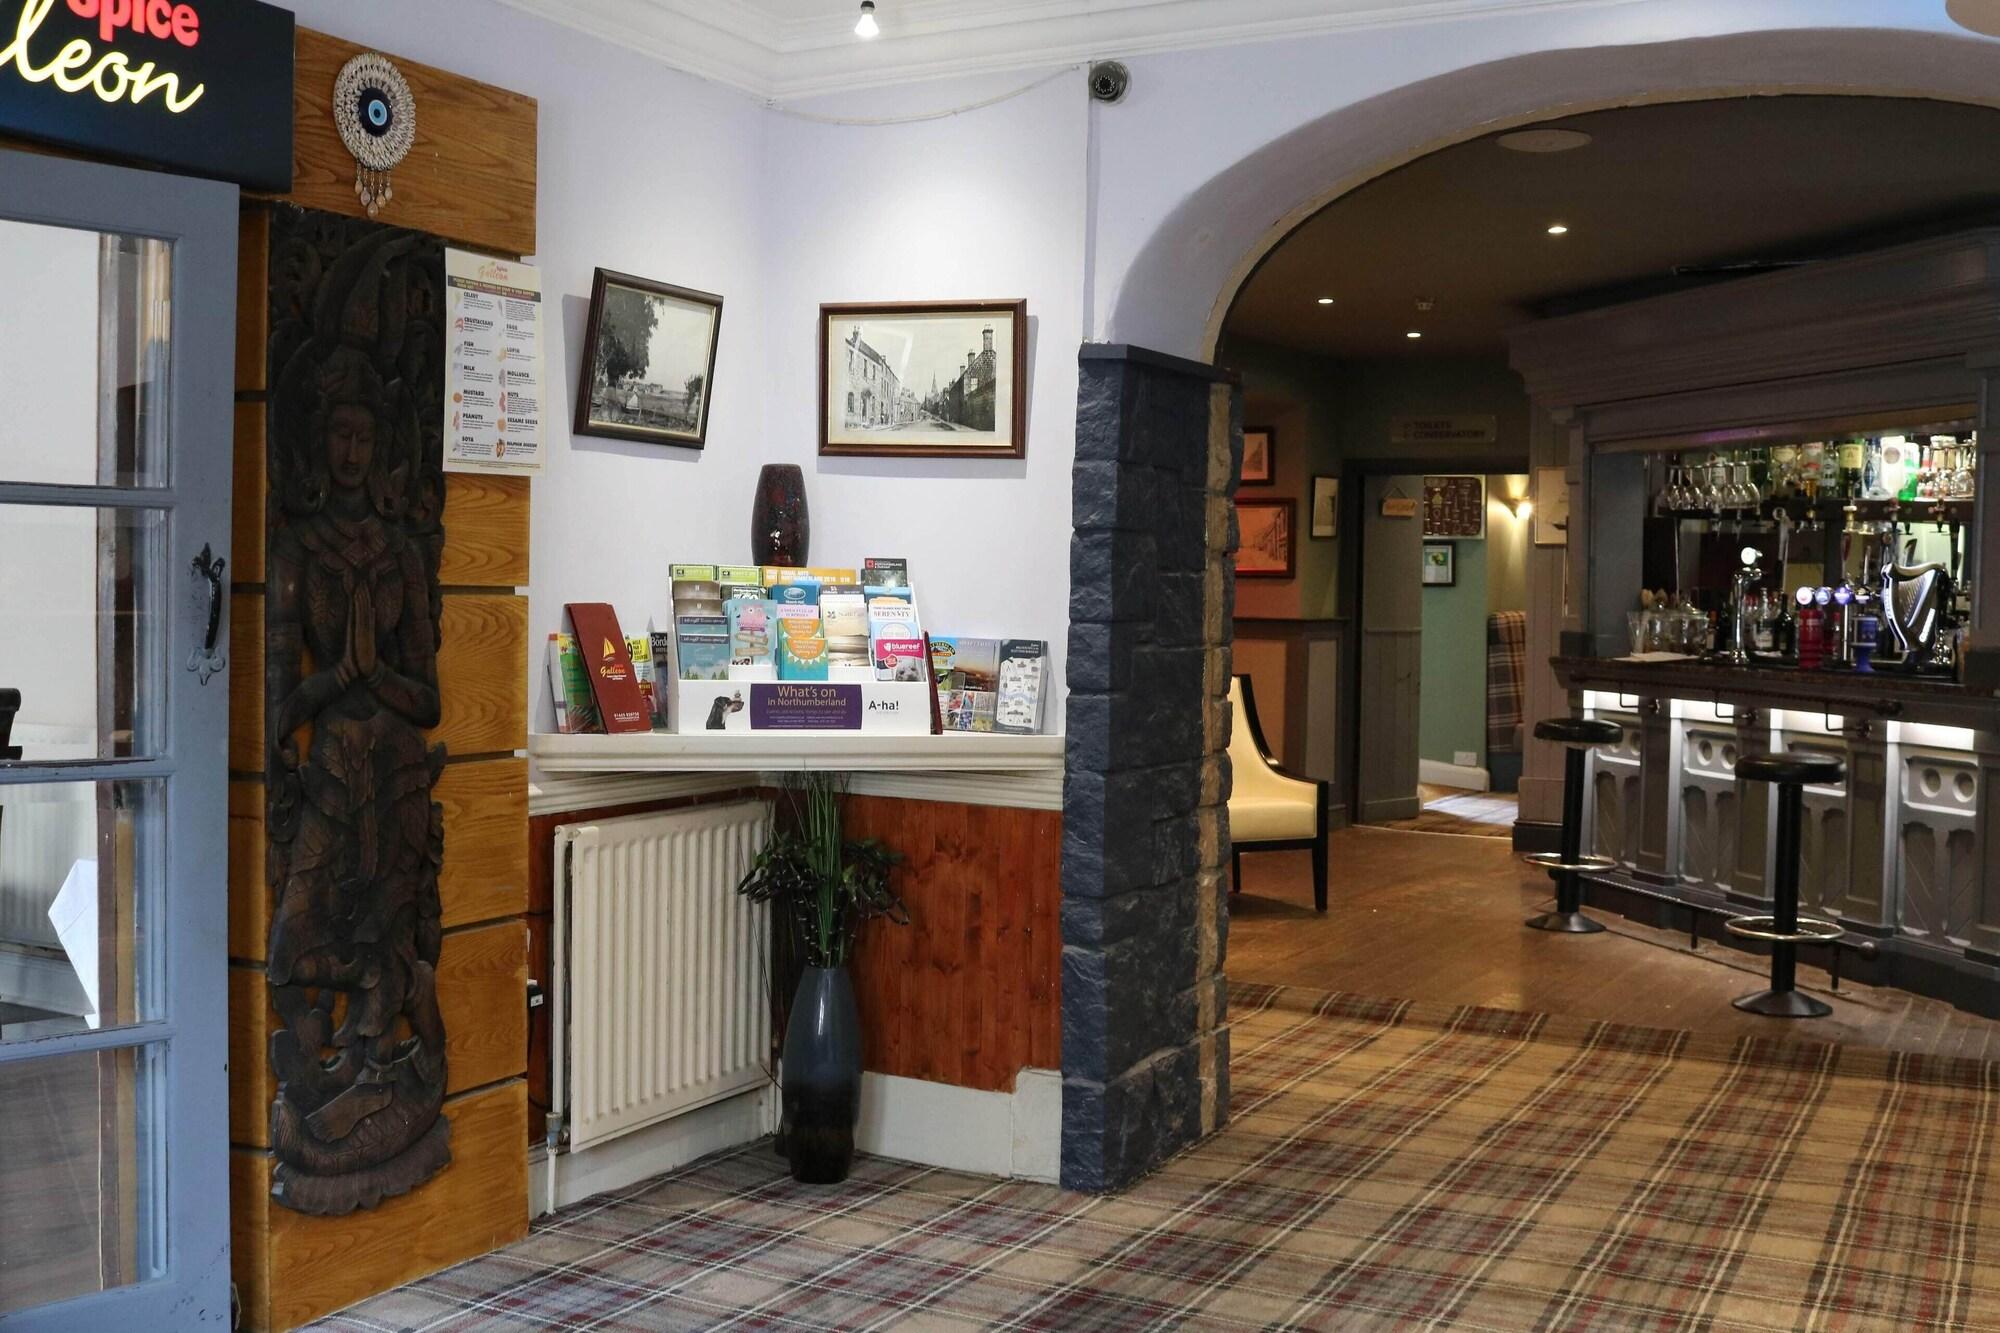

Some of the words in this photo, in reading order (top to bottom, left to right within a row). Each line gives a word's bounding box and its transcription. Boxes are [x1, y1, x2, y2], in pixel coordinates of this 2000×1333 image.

[891, 642, 920, 650] bluereef
[777, 685, 817, 698] What's
[820, 688, 836, 698] on
[767, 698, 776, 706] in
[777, 697, 846, 706] Northumberland
[868, 700, 899, 711] A-ha!
